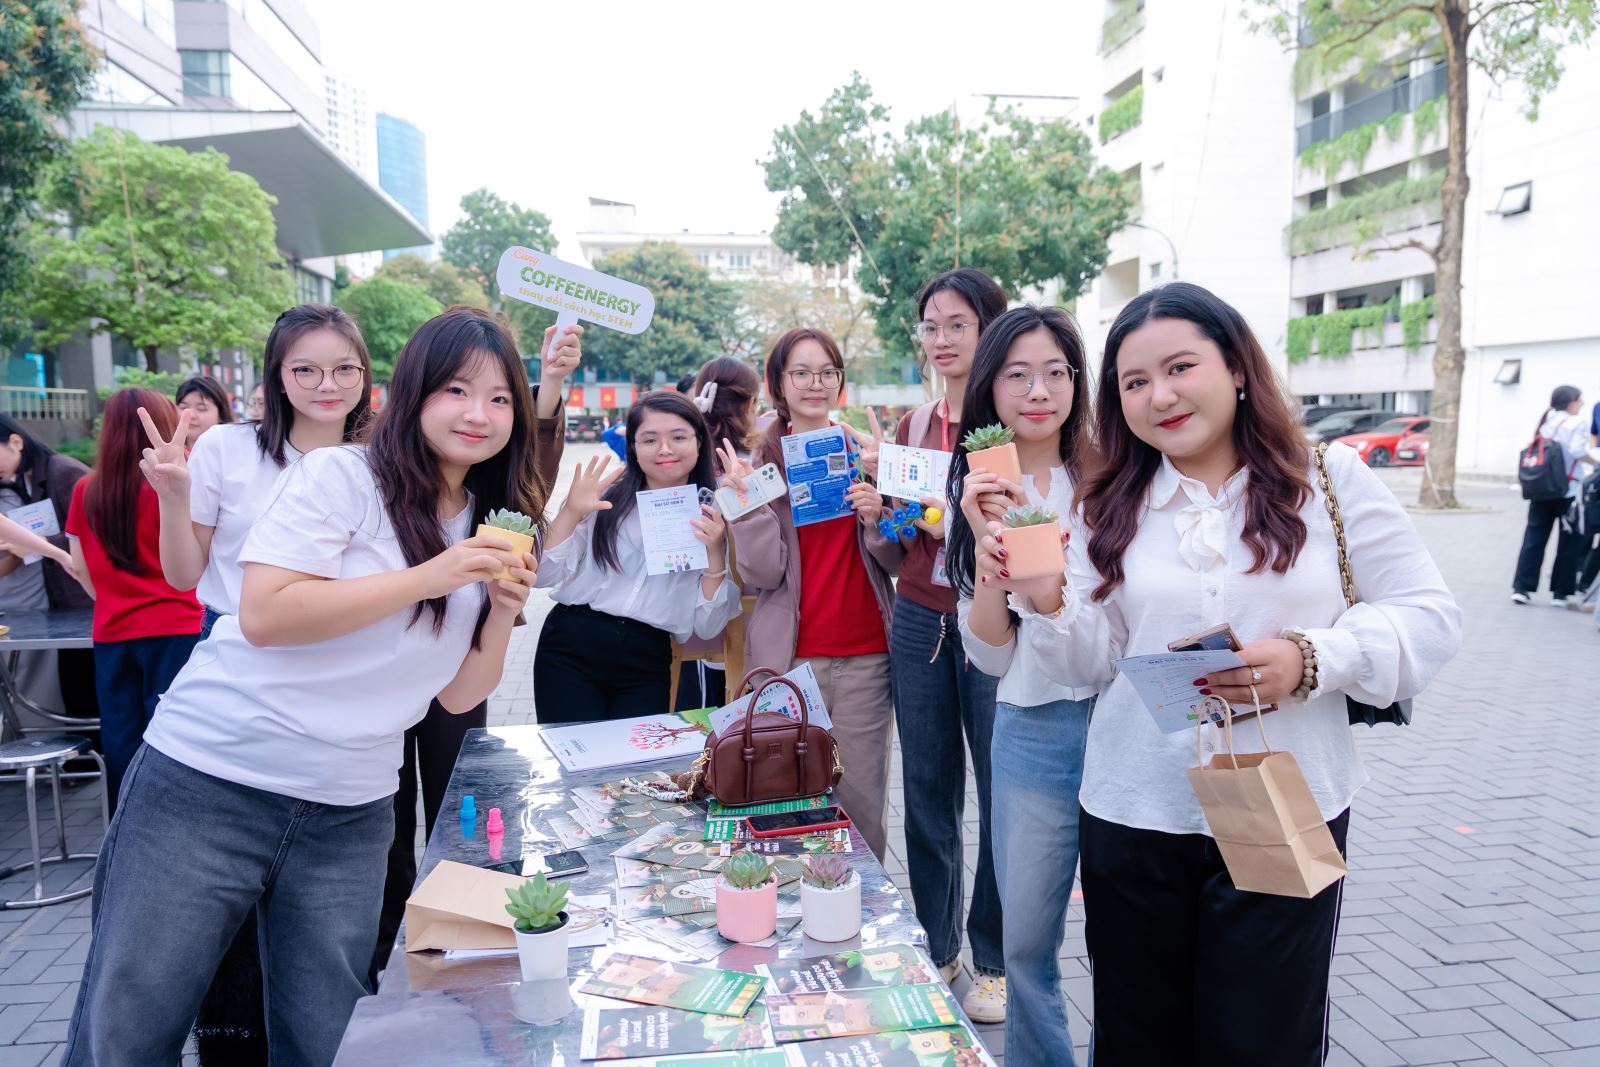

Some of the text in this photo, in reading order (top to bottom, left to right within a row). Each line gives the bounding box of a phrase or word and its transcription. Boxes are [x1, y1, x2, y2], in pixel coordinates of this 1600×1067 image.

[519, 287, 545, 302] thay
[564, 301, 587, 316] cách
[589, 308, 607, 321] học
[608, 314, 633, 329] STEM
[520, 266, 642, 315] COFFEENERGY
